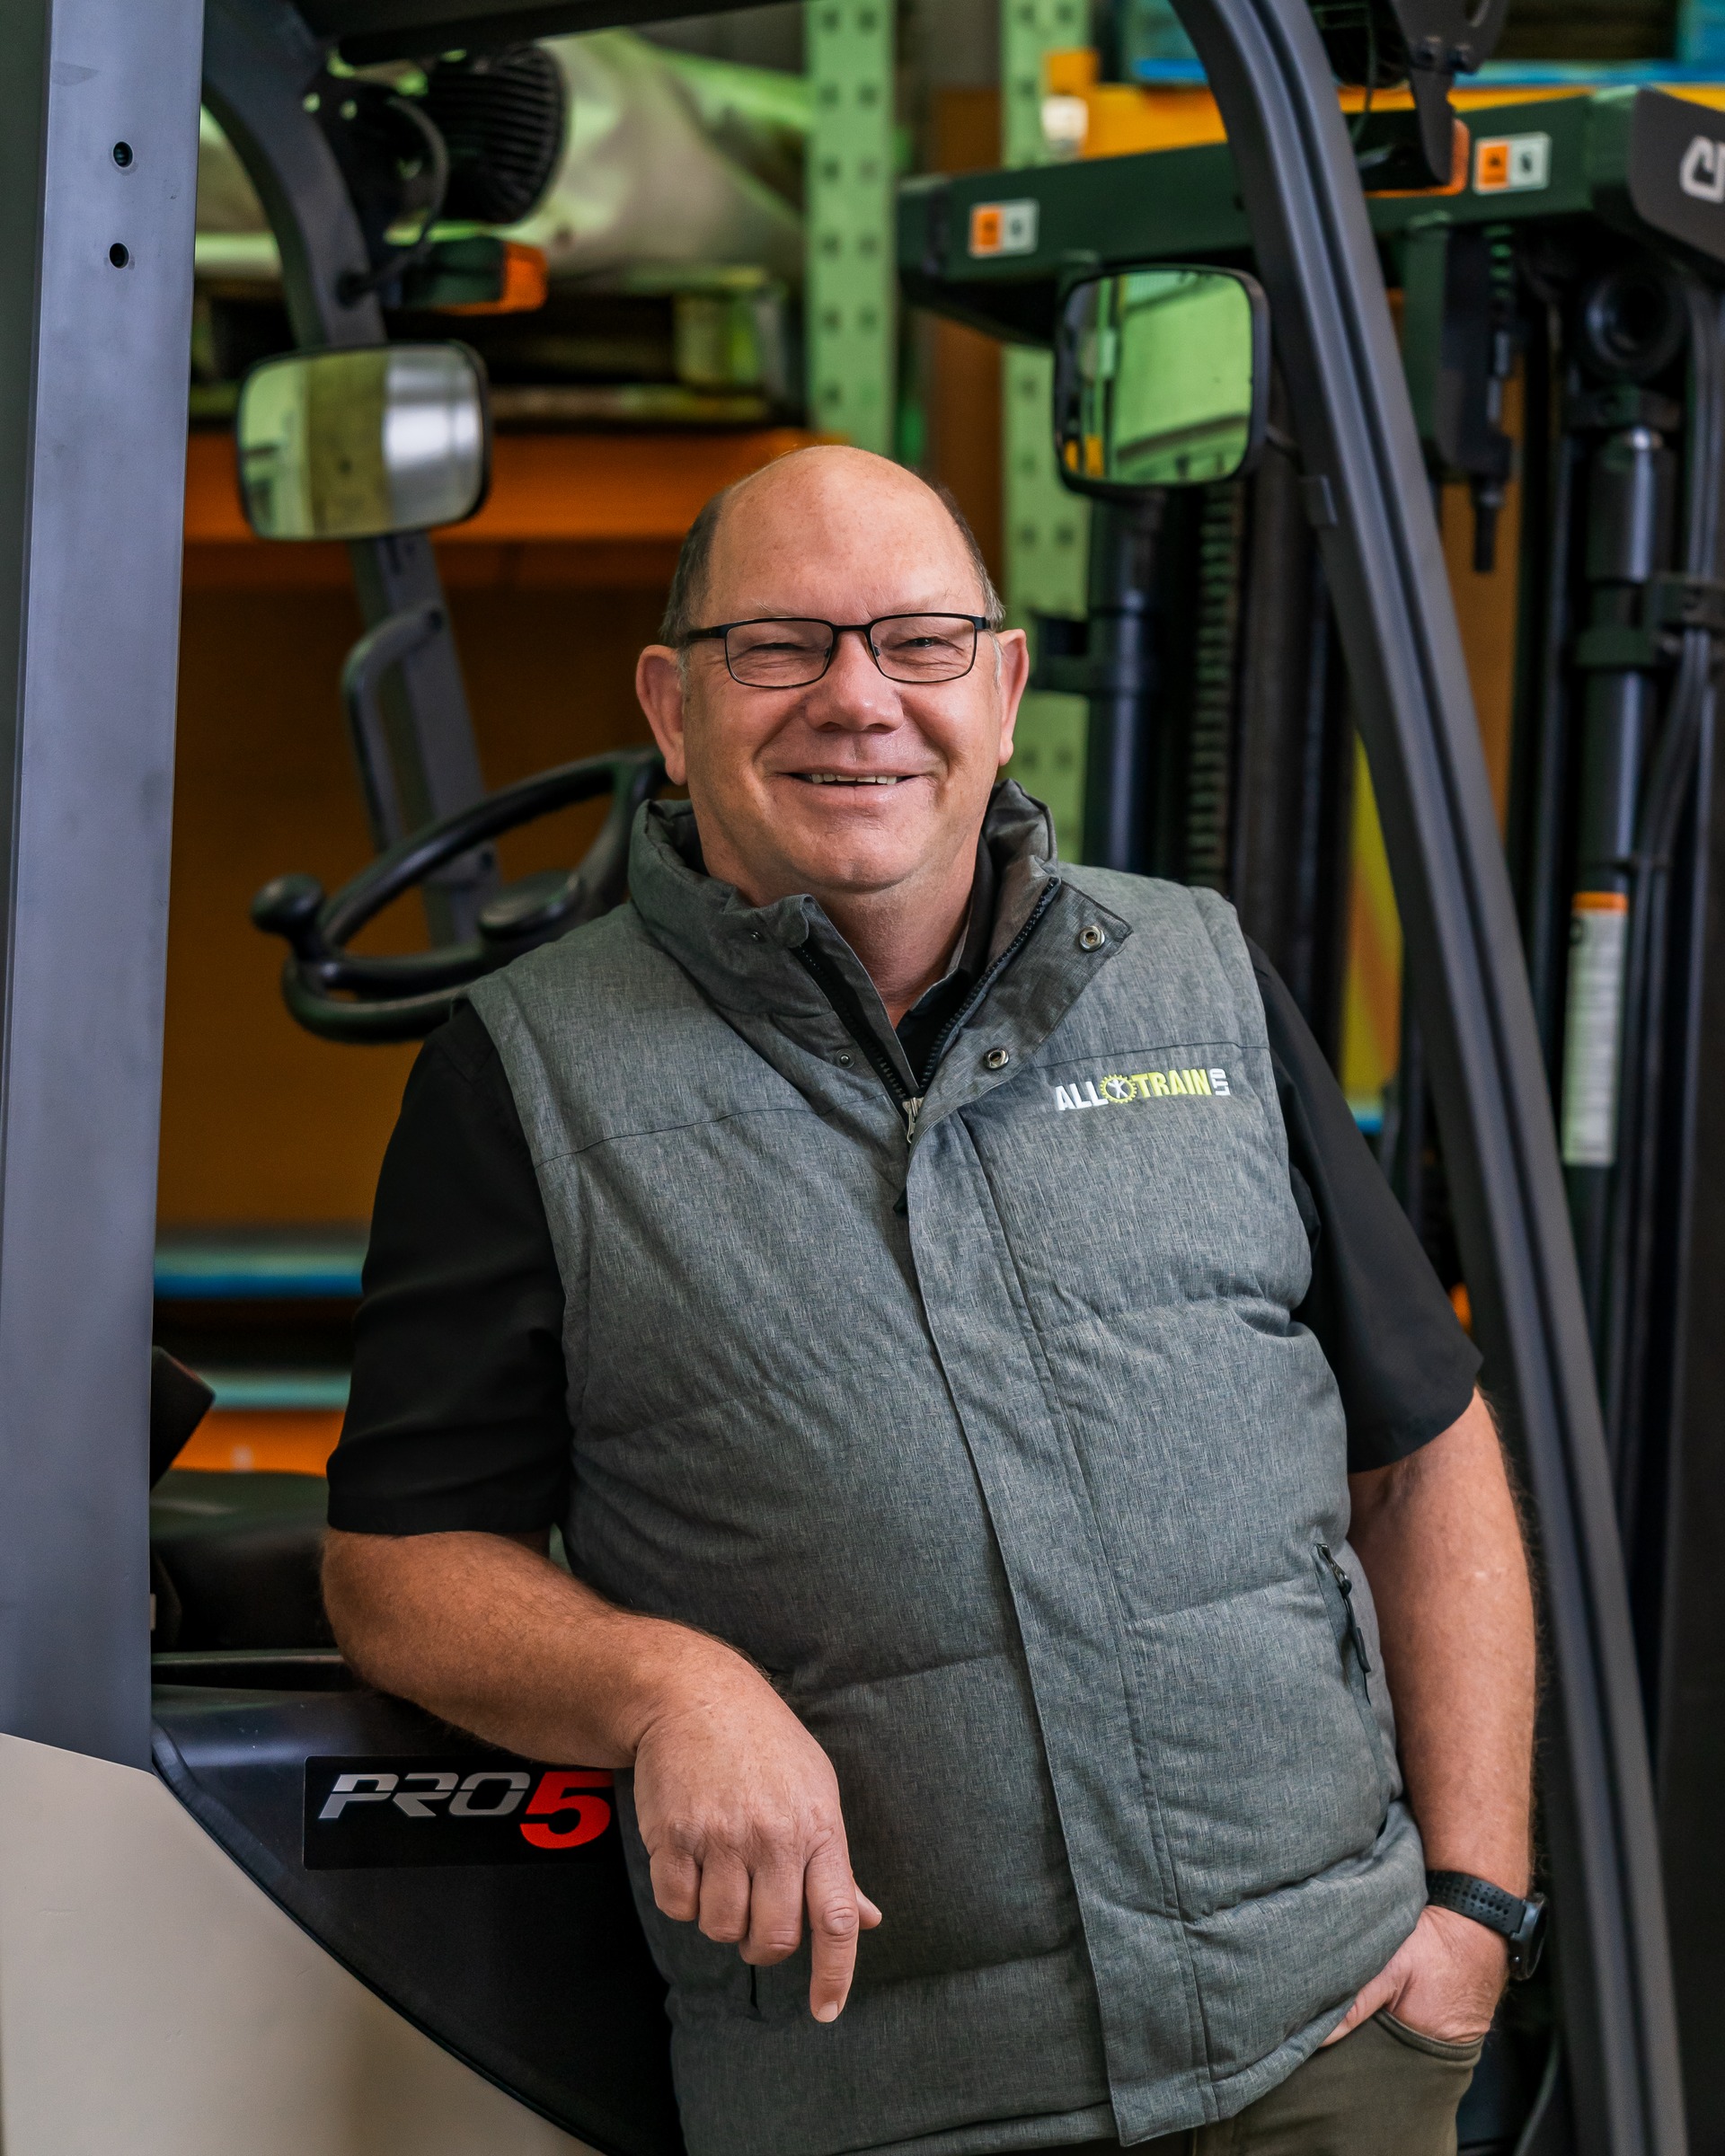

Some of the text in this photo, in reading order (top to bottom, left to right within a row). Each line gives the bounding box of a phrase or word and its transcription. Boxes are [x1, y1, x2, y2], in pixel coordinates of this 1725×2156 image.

[1055, 1067, 1231, 1111] ALL TRAIN LTD
